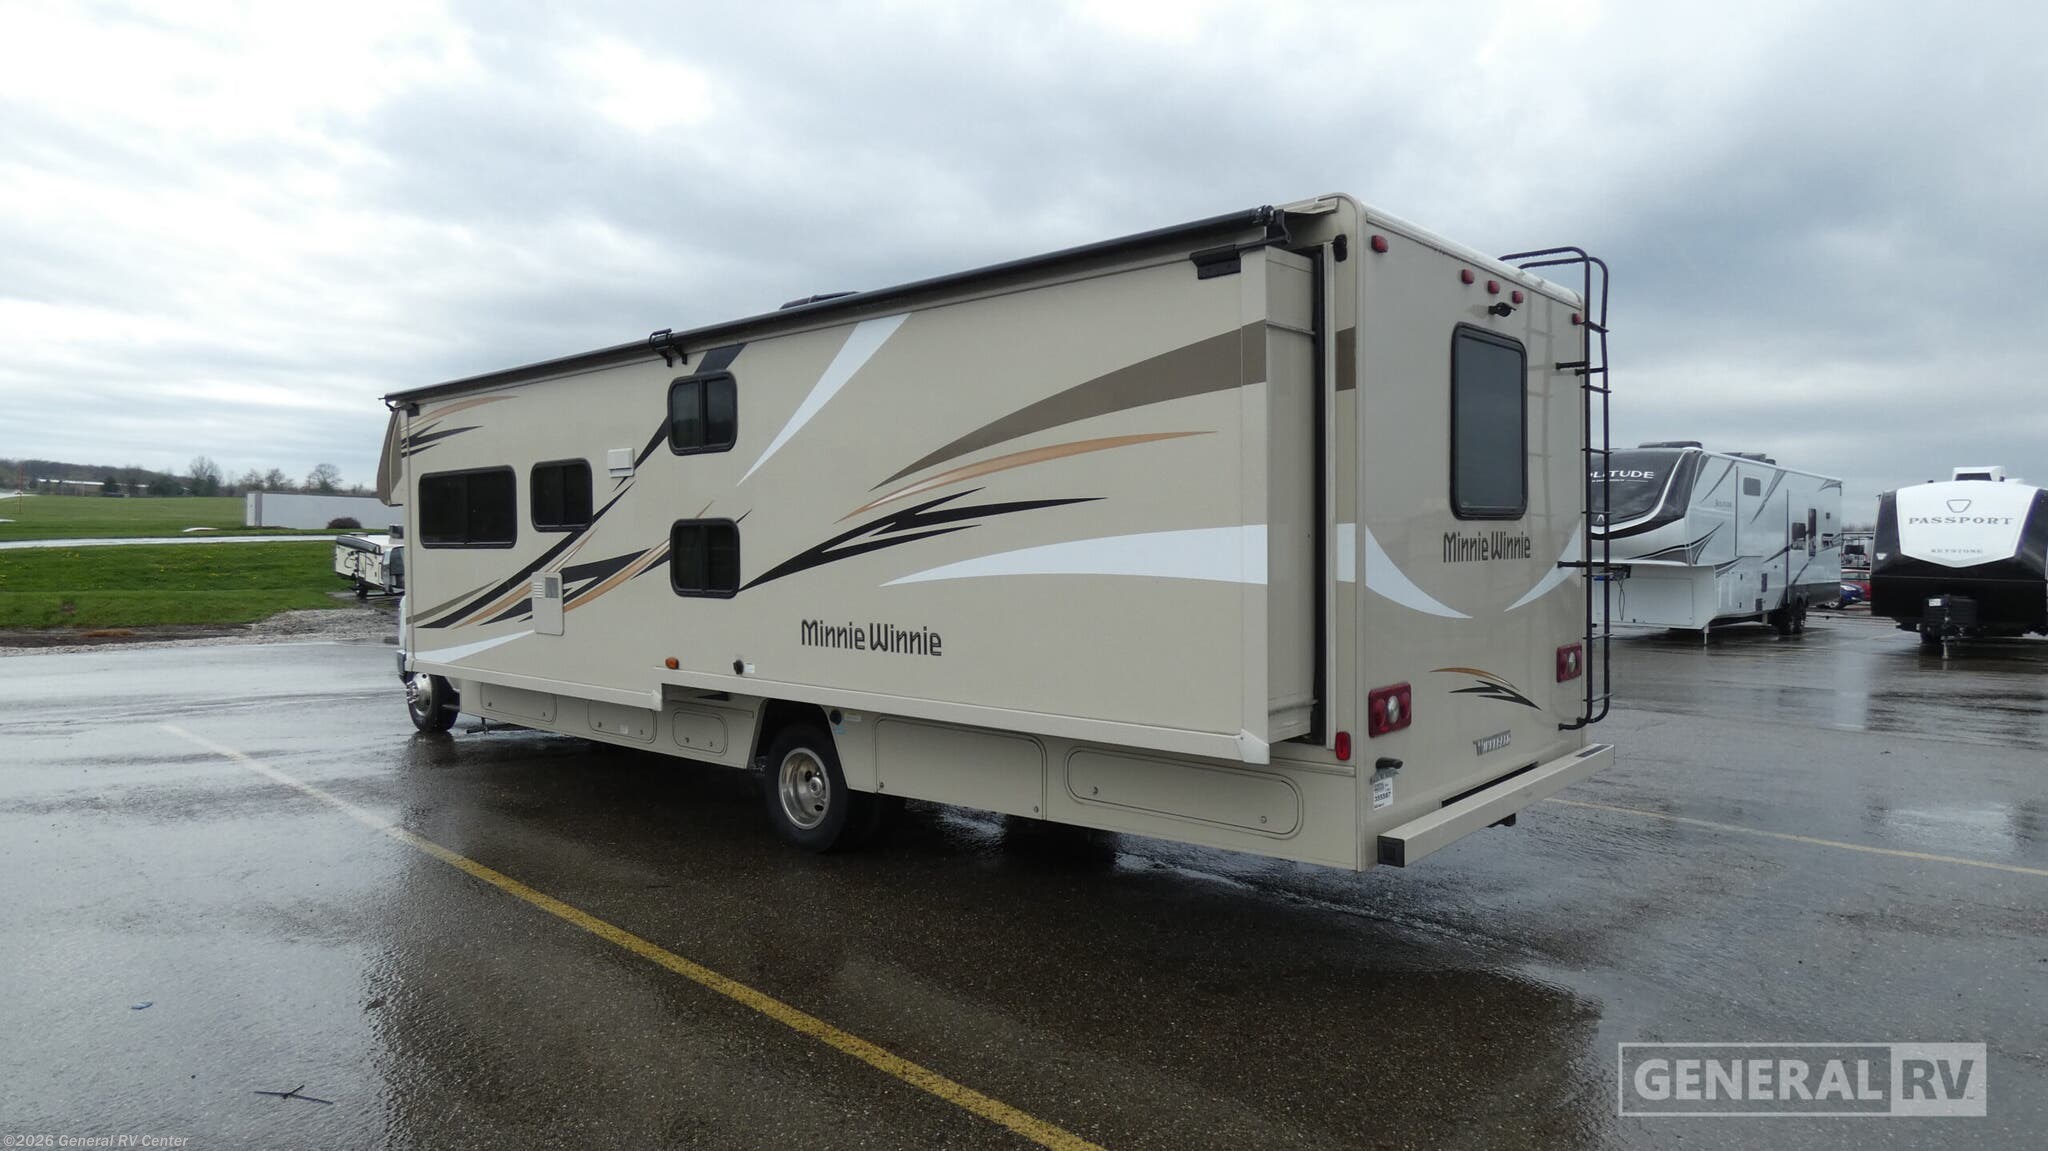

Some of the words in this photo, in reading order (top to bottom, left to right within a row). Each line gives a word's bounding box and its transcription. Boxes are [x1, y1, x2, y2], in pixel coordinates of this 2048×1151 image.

[1590, 470, 1655, 479] LTUDE
[1908, 516, 2015, 525] PASSPORT
[1443, 531, 1489, 563] Minnie
[1491, 531, 1531, 560] Winnie
[801, 619, 866, 650] Minnie
[869, 622, 942, 656] Winnie
